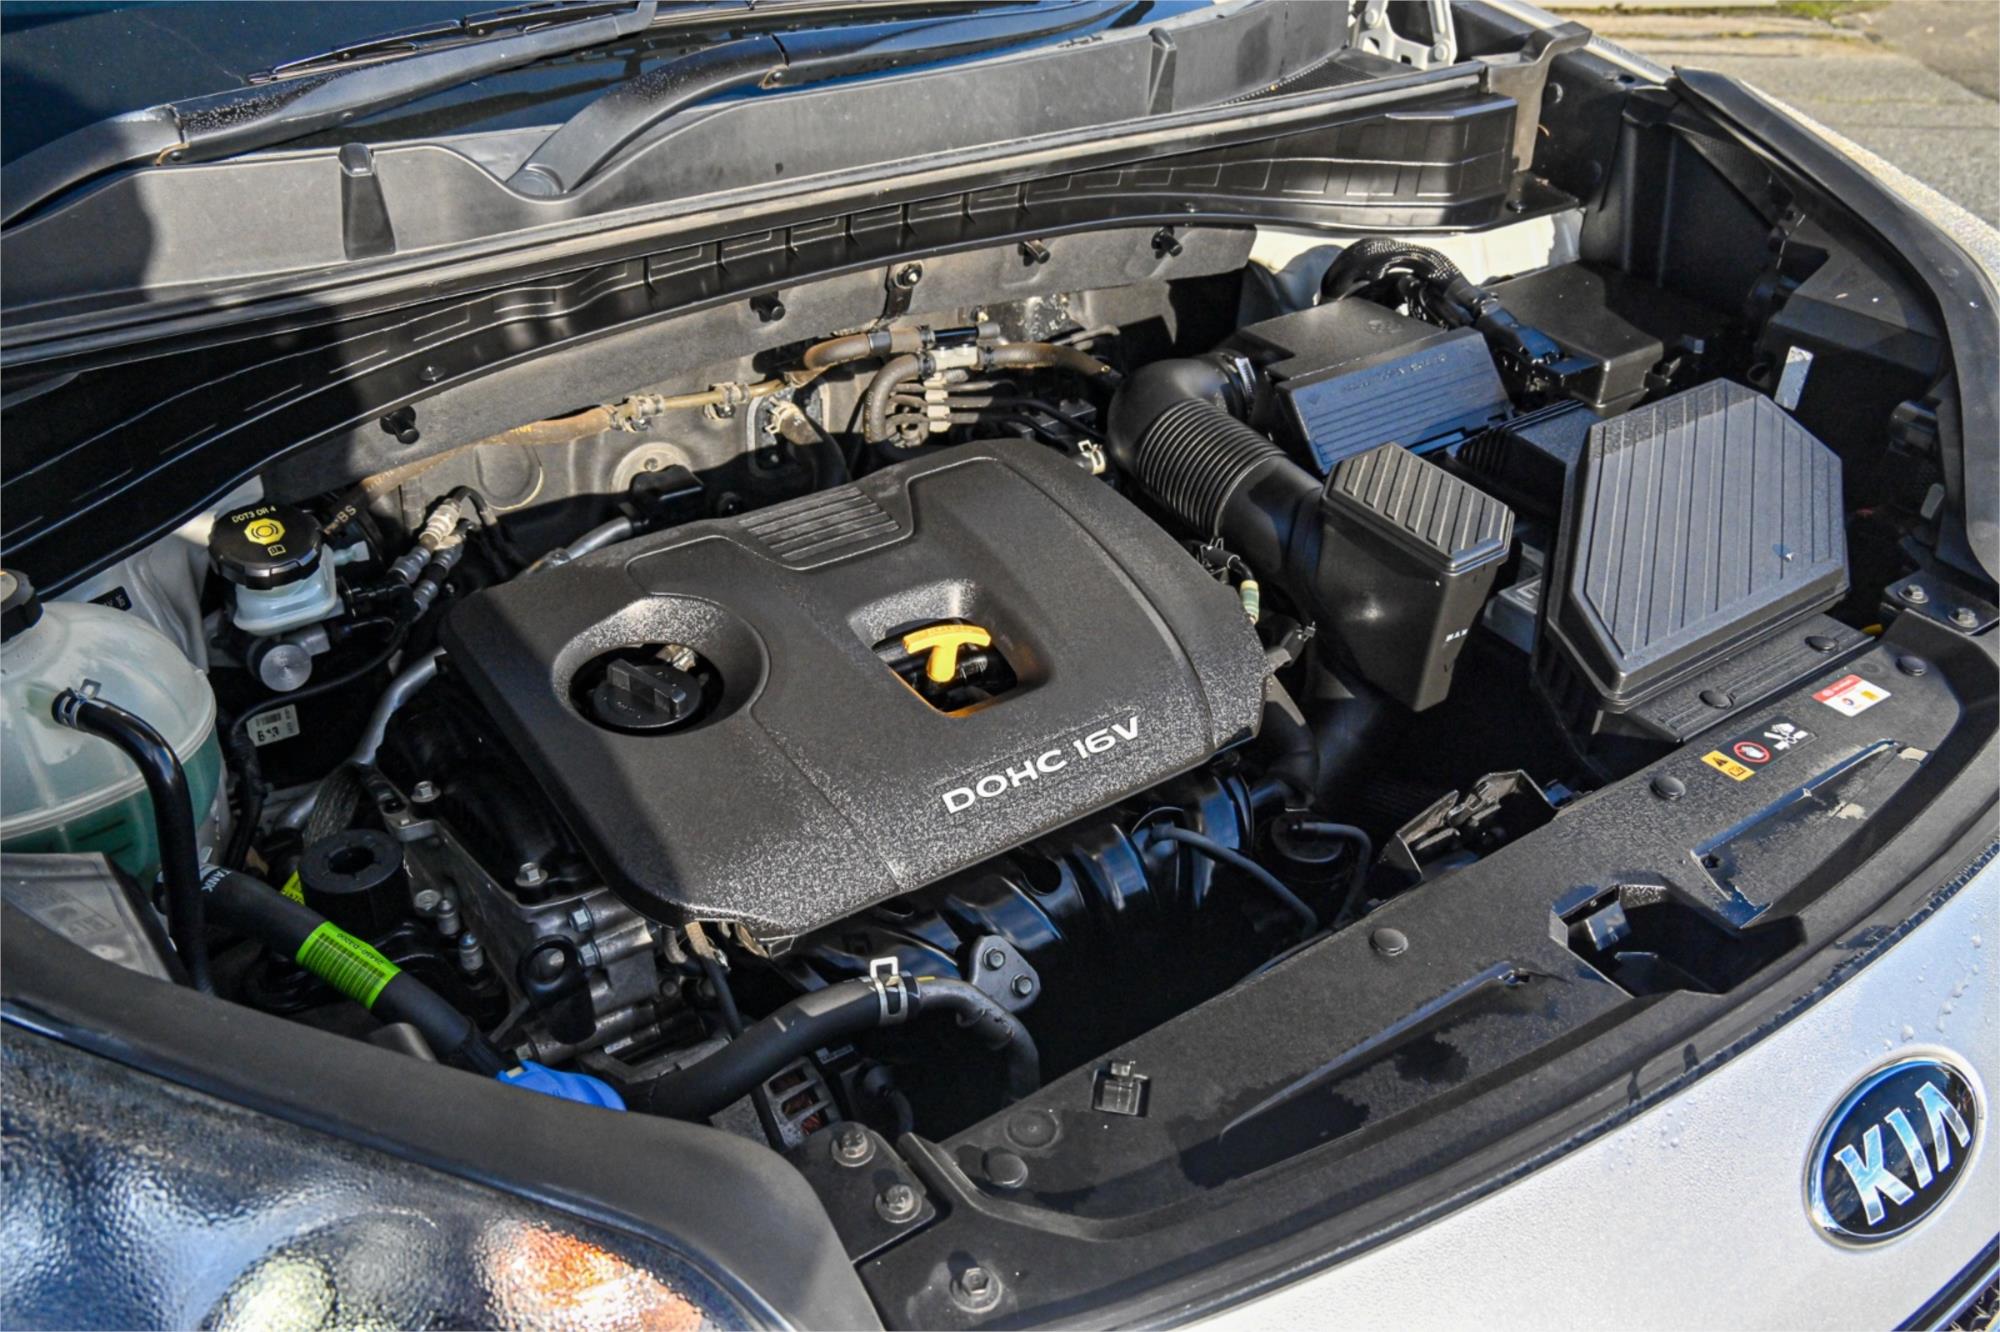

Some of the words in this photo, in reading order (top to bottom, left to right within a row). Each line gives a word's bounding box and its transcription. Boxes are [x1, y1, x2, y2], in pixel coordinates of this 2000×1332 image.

[232, 511, 255, 523] DOT3
[256, 507, 269, 516] OR
[942, 750, 1068, 814] DOHC
[1073, 716, 1138, 759] 16V
[201, 868, 232, 893] TANK
[1833, 1081, 1971, 1226] KIA
